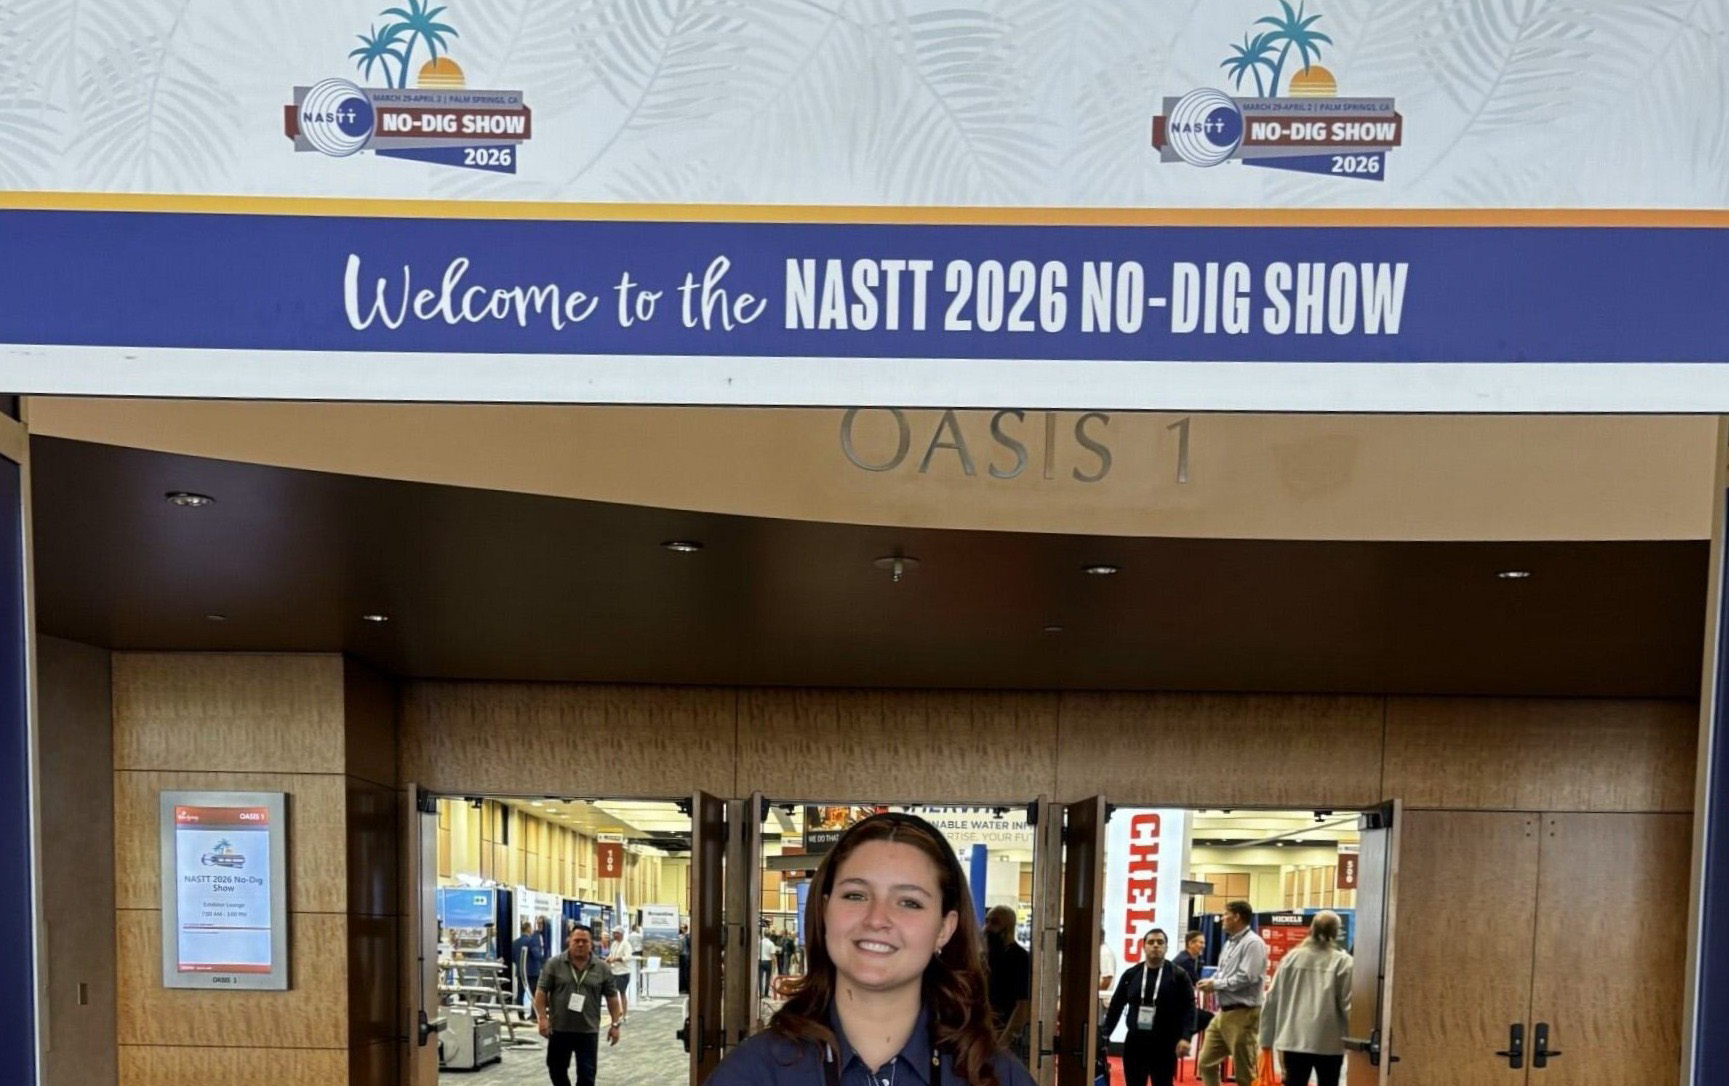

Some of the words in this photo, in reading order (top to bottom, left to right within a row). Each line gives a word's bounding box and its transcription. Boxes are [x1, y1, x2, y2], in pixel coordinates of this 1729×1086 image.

[1243, 103, 1270, 111] MARCH
[1272, 103, 1306, 111] 29-APRIL
[303, 108, 357, 123] NASTT
[383, 113, 457, 133] NO-DIG
[462, 115, 525, 134] SHOW
[1171, 118, 1224, 133] NASTT
[1251, 122, 1326, 141] NO-DIG
[1331, 123, 1396, 141] SHOW
[464, 149, 512, 166] 2026
[1331, 156, 1379, 173] 2026
[344, 254, 598, 331] Welcome
[613, 271, 662, 328] to
[677, 255, 767, 331] the
[785, 258, 933, 331] NASTT
[944, 259, 1068, 333] 2026
[1081, 261, 1251, 335] NO-DIG
[1264, 262, 1408, 335] SHOW
[840, 406, 1113, 483] OASIS
[1166, 415, 1191, 484] 1
[240, 813, 260, 821] OASIS
[971, 820, 1009, 830] WATER
[817, 835, 826, 843] DO
[982, 832, 1011, 842] YOUR
[184, 875, 211, 883] NASTT
[213, 876, 232, 884] 2026
[234, 876, 263, 886] No-Dig
[213, 884, 235, 892] Show
